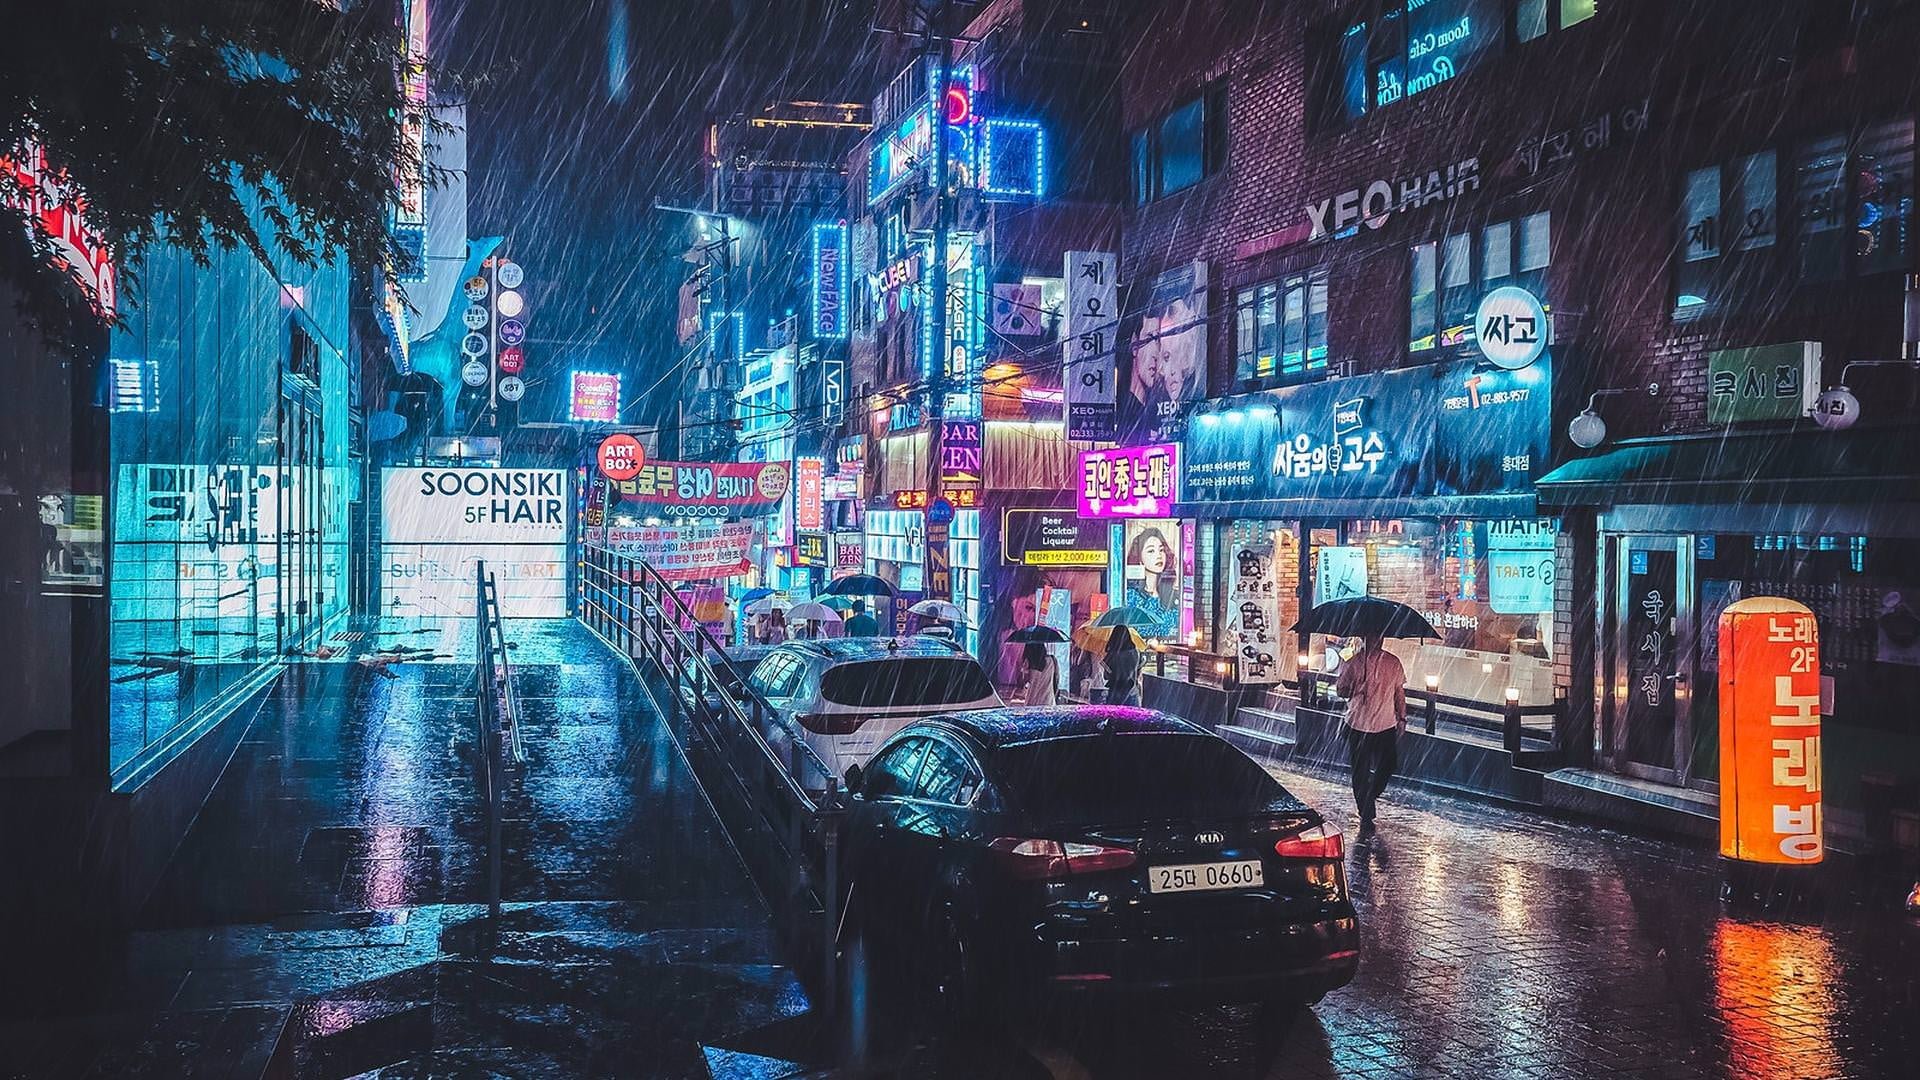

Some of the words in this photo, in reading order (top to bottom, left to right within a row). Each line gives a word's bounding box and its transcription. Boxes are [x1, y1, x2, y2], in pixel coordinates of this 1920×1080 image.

[1305, 180, 1392, 241] XEO
[1400, 157, 1480, 213] HAIR
[1081, 260, 1105, 393] 제오헤어
[1483, 314, 1538, 346] 싸고
[1713, 364, 1800, 402] 국시집
[1072, 407, 1094, 415] XEO
[605, 445, 635, 457] ART
[1273, 433, 1327, 478] 싸움의
[1342, 432, 1385, 474] 고수
[606, 459, 635, 470] BOX
[1502, 455, 1529, 472] 홍대점
[421, 472, 561, 496] SOONSIKI
[465, 507, 487, 523] 5F
[491, 500, 562, 523] HAIR
[1043, 517, 1062, 525] Beer
[1043, 527, 1078, 535] Cocktail
[1043, 537, 1075, 546] Liqueur
[840, 546, 862, 555] BAR
[840, 555, 862, 564] ZEN
[1642, 589, 1664, 706] 국시집
[1790, 646, 1816, 673] 2F
[1770, 675, 1822, 861] 노래방
[1199, 834, 1220, 844] KIA
[1160, 869, 1197, 889] 25다
[1206, 864, 1253, 885] 0660
